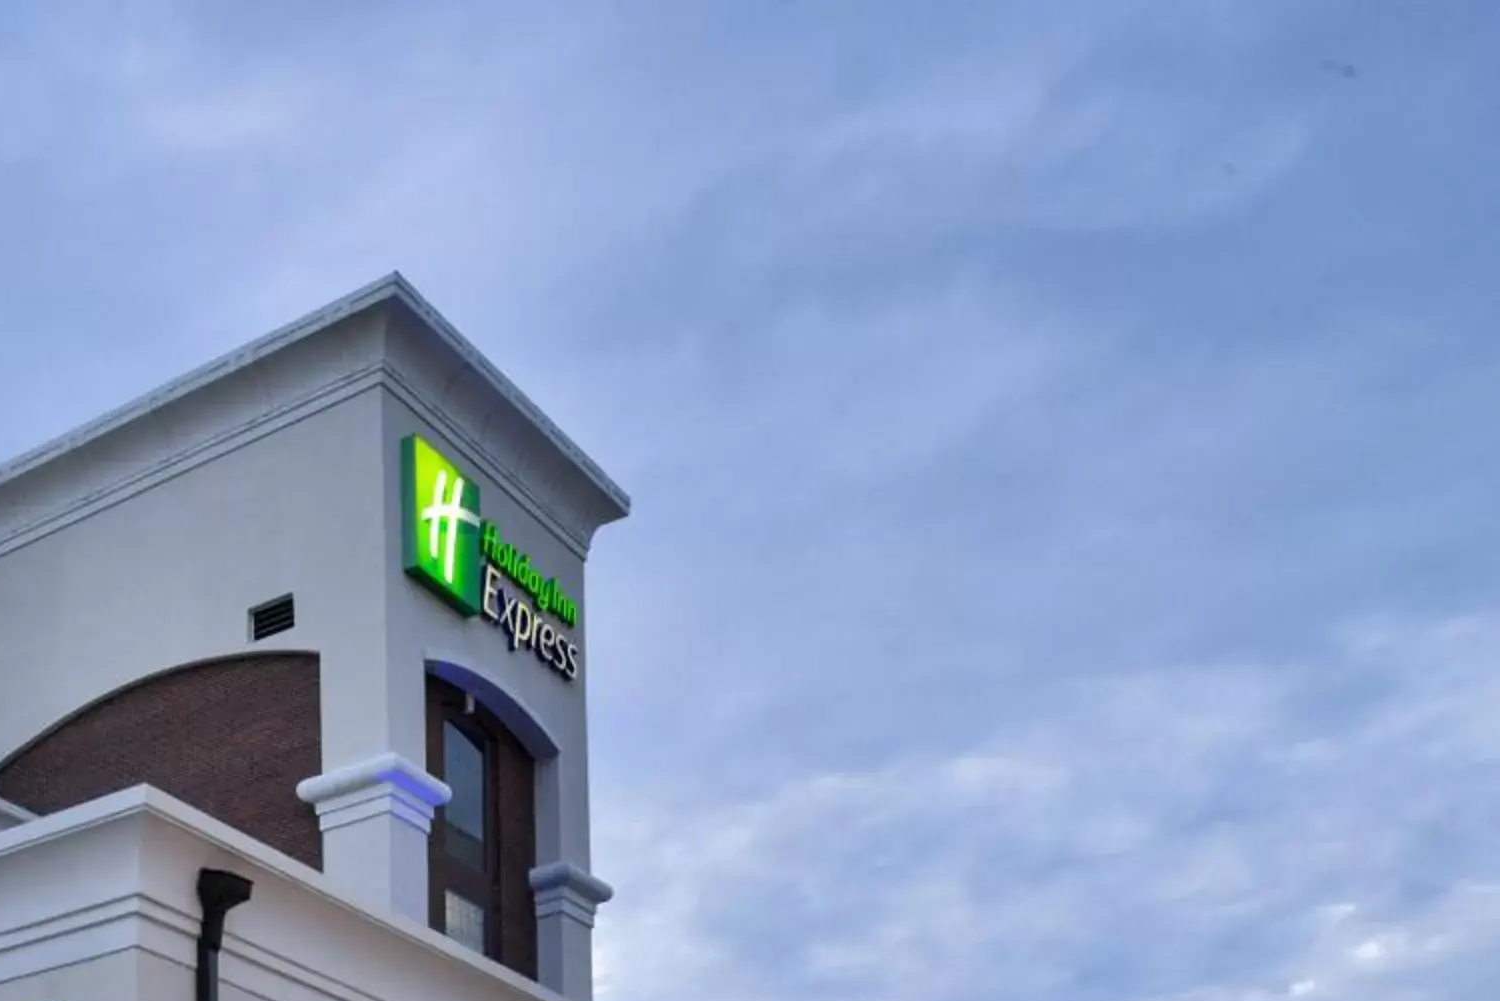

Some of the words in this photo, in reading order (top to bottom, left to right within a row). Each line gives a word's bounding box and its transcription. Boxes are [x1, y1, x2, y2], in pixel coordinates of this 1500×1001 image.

[421, 470, 481, 584] H
[481, 519, 550, 610] Holiday
[549, 576, 577, 627] Inn
[482, 562, 579, 680] Express
